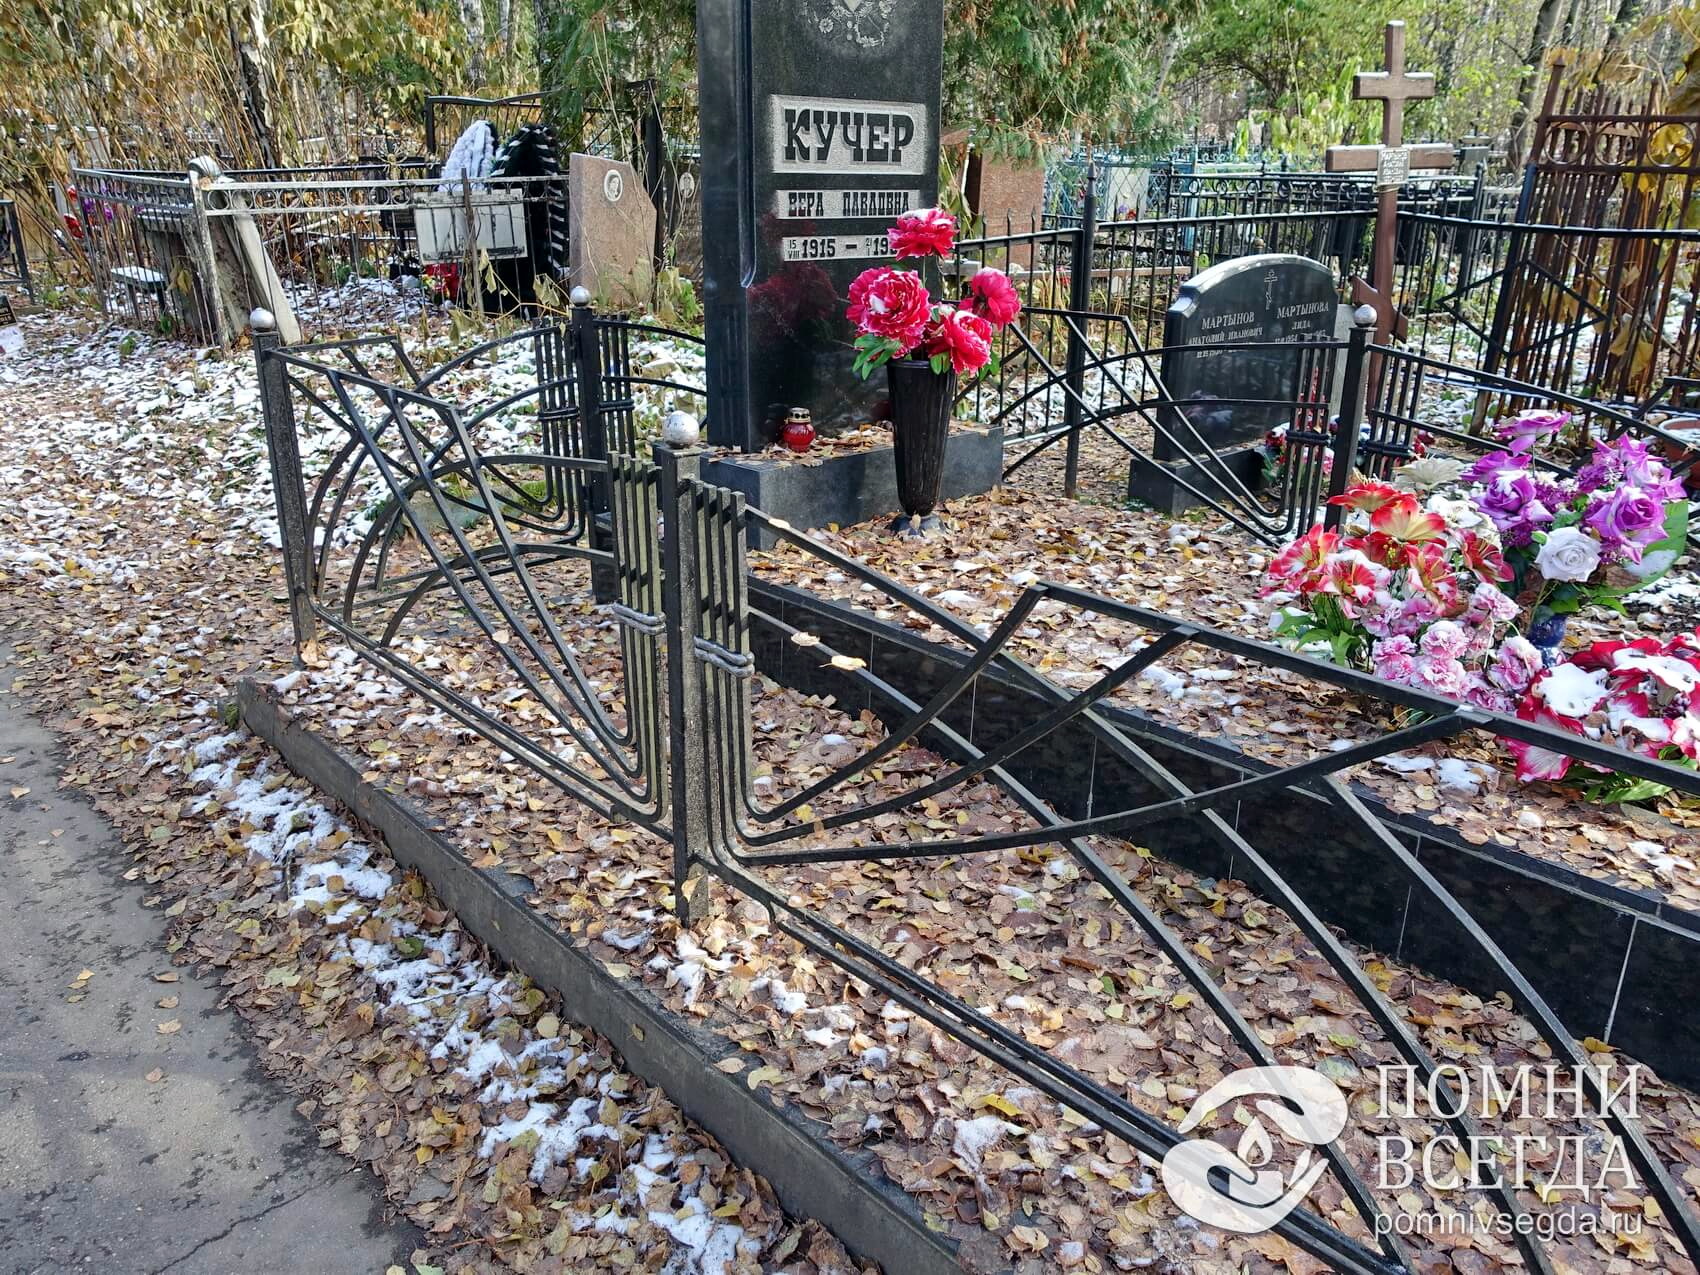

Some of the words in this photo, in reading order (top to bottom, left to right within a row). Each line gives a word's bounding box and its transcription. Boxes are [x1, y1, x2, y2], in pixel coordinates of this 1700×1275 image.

[784, 108, 915, 163] КУЧЕР
[788, 191, 824, 217] ВЕРА
[843, 191, 910, 217] ПАВЛОВНА
[802, 238, 836, 259] 1915
[1201, 311, 1256, 330] МАРТЫНОВ
[1276, 301, 1330, 320] МАРТЫНОВА
[1188, 330, 1225, 345] АНАТОЛИЙ
[1228, 327, 1264, 341] ИВАНОВИЧ
